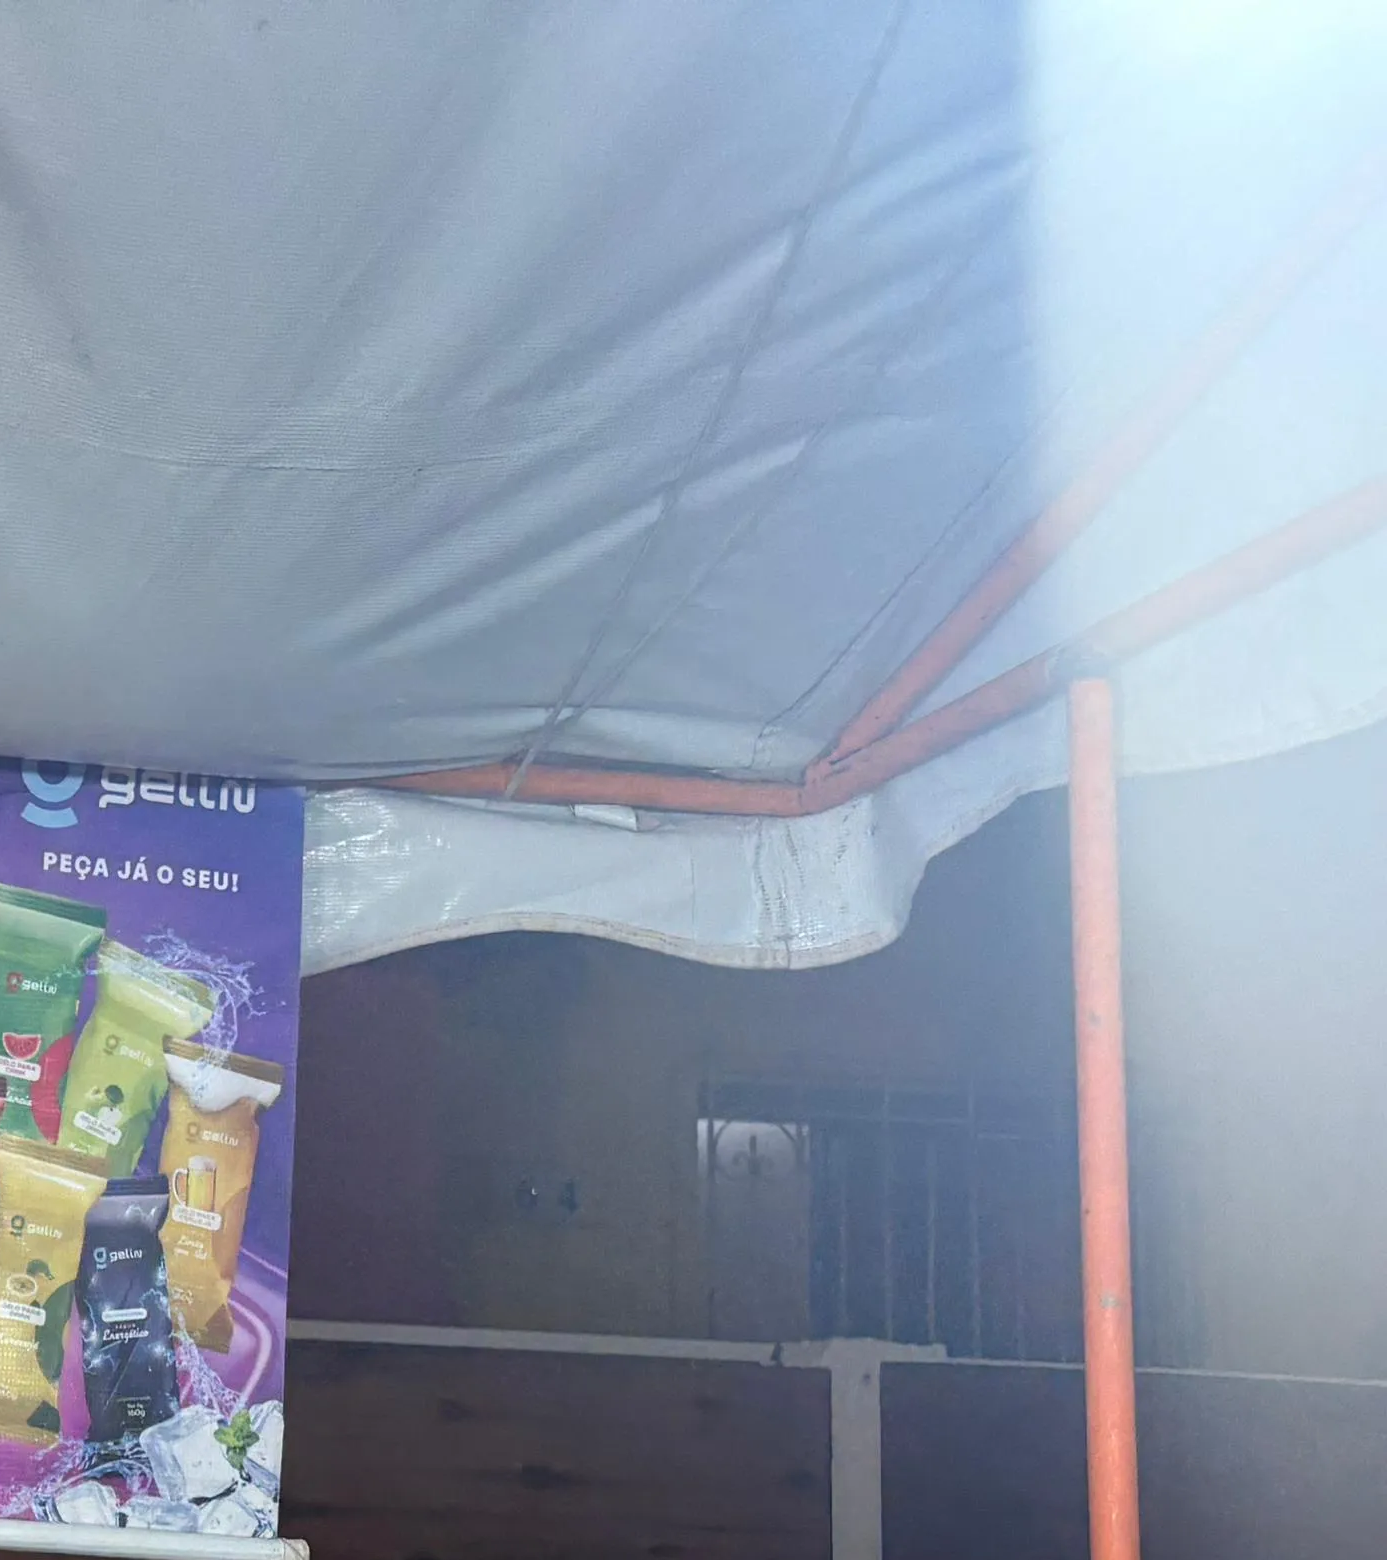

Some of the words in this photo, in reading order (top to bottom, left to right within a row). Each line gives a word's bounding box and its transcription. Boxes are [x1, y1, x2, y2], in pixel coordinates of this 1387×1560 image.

[43, 852, 109, 881] PEÇA
[117, 856, 149, 882] JÁ
[156, 865, 174, 884] O
[182, 868, 239, 893] SEU!
